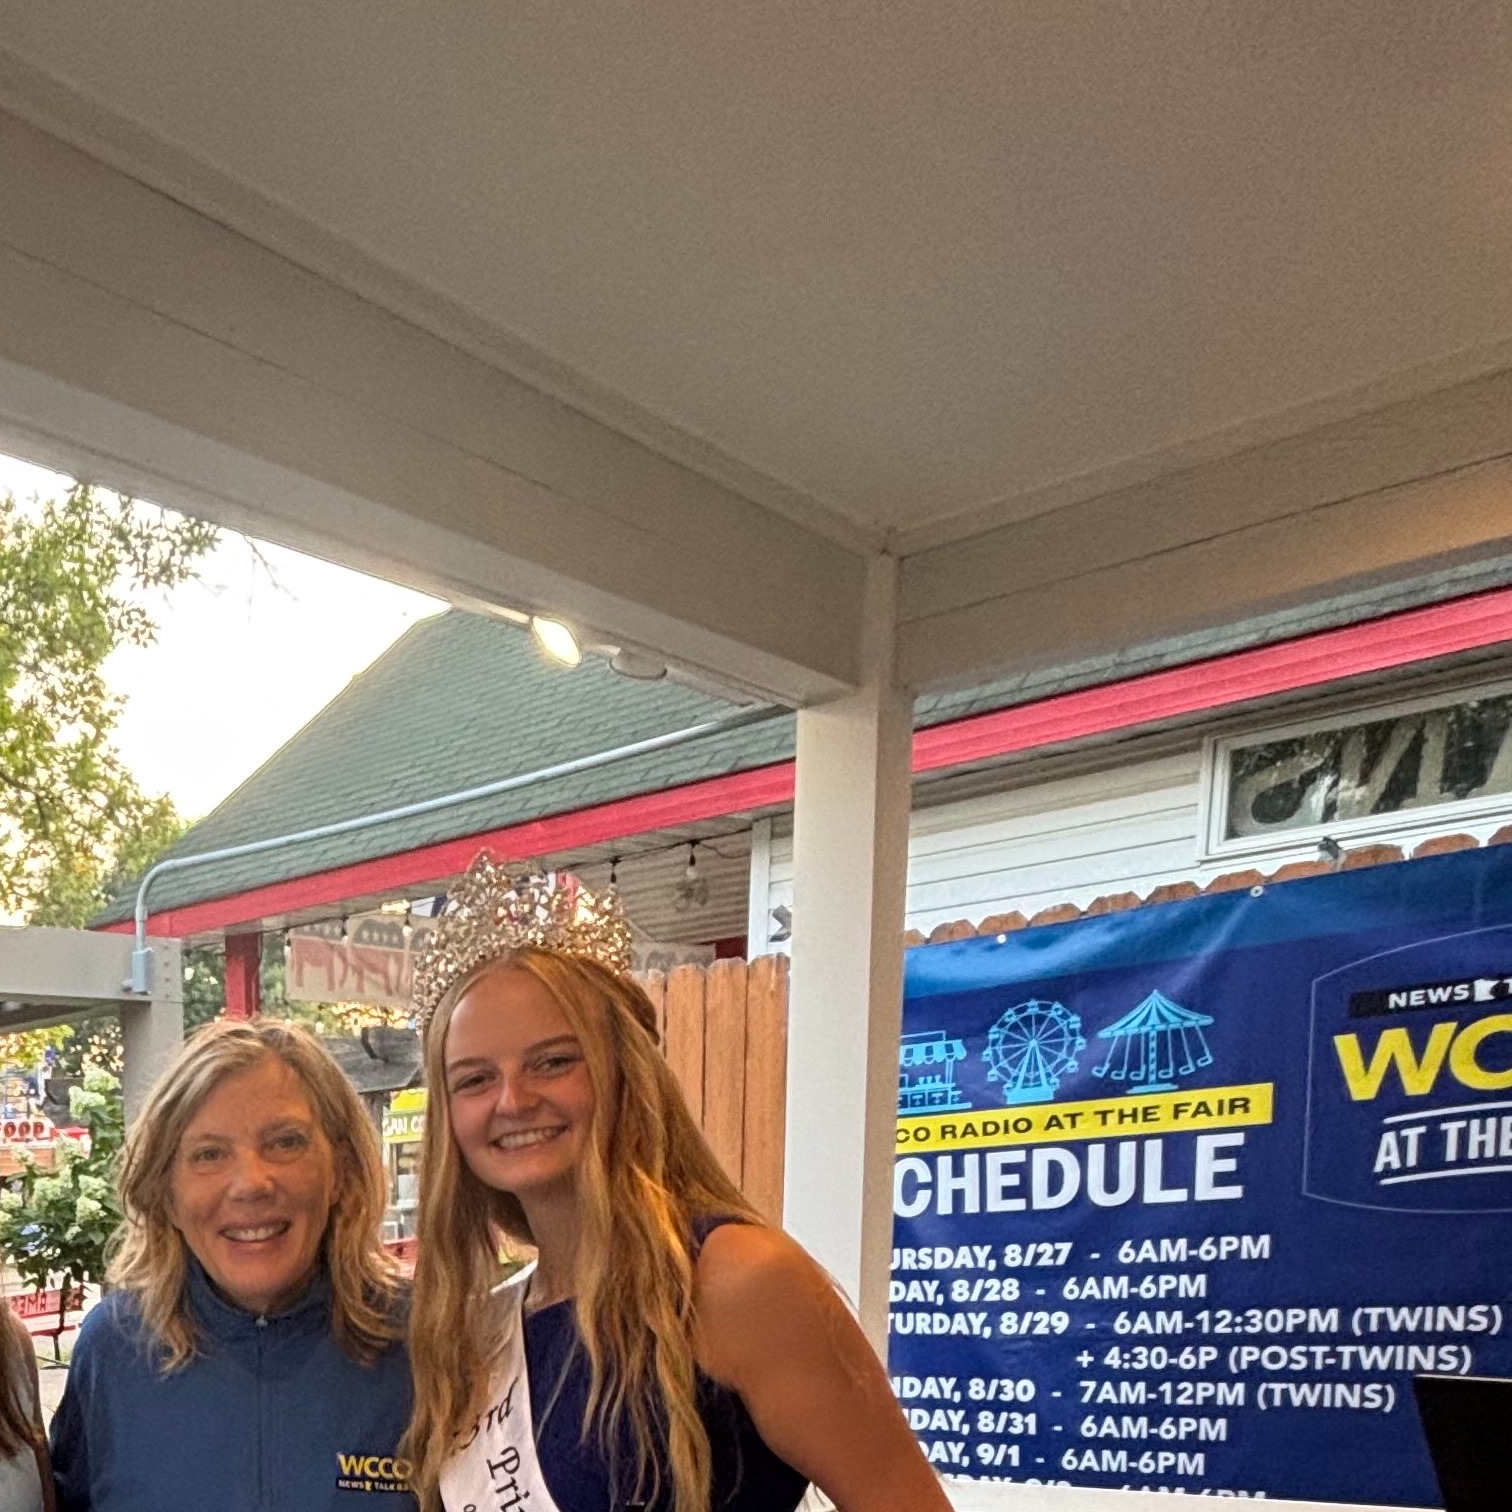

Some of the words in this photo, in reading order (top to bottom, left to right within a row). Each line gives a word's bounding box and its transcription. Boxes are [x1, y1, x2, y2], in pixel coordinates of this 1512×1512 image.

[1389, 984, 1469, 1009] NEWS
[941, 1117, 1033, 1140] RADIO
[1044, 1112, 1085, 1131] AT
[1093, 1105, 1161, 1126] THE
[1173, 1097, 1251, 1120] FAIR
[1374, 1126, 1427, 1173] AT
[893, 1132, 1245, 1218] CHEDULE
[1004, 1242, 1073, 1267] 8/27
[1118, 1234, 1271, 1263] 6AM-6PM
[889, 1279, 943, 1305] DAY,
[951, 1278, 1020, 1302] 8/28
[1062, 1274, 1207, 1300] 6AM-6PM
[1000, 1311, 1069, 1335] 8/29
[1114, 1308, 1339, 1335] 6AM-12:30PM
[1352, 1304, 1502, 1336] (TWINS)
[1076, 1350, 1095, 1368] +
[1103, 1346, 1218, 1370] 4:30-6P
[1228, 1345, 1472, 1374] (POST-TWINS)
[968, 1378, 1036, 1402] 8/30
[1079, 1381, 1245, 1406] 7AM-12PM
[1257, 1383, 1395, 1413] (TWINS)
[977, 1410, 1036, 1435] 8/31
[1080, 1415, 1227, 1441] 6AM-6PM
[337, 1454, 414, 1480] WCCO
[976, 1443, 1020, 1467] 9/1
[1061, 1448, 1206, 1475] 6AM-6PM
